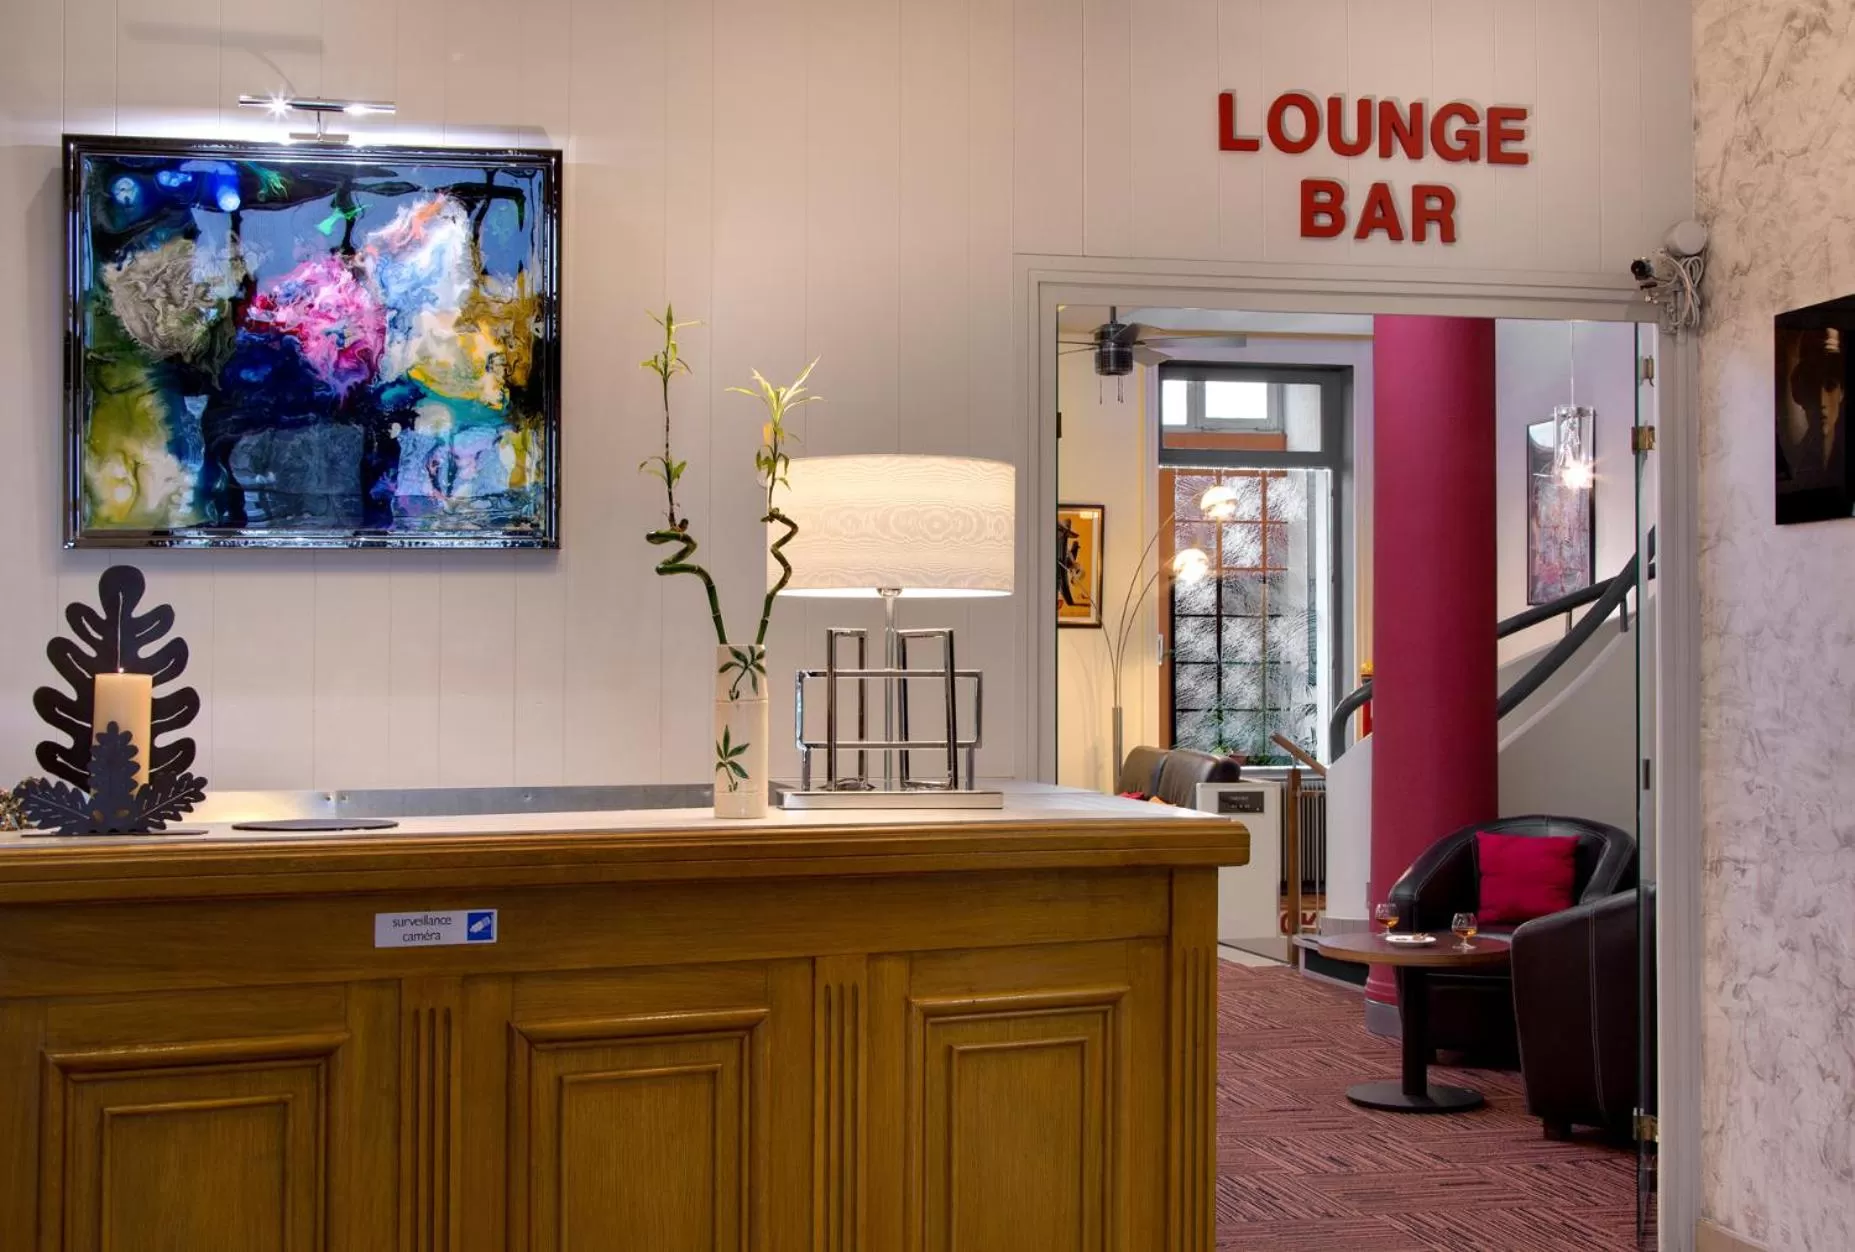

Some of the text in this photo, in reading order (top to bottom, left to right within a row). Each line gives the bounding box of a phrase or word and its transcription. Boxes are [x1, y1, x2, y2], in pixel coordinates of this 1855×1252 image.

[1218, 92, 1529, 165] LOUNGE
[1300, 179, 1456, 243] BAR
[392, 914, 453, 928] surveillance
[402, 929, 441, 942] caméra
